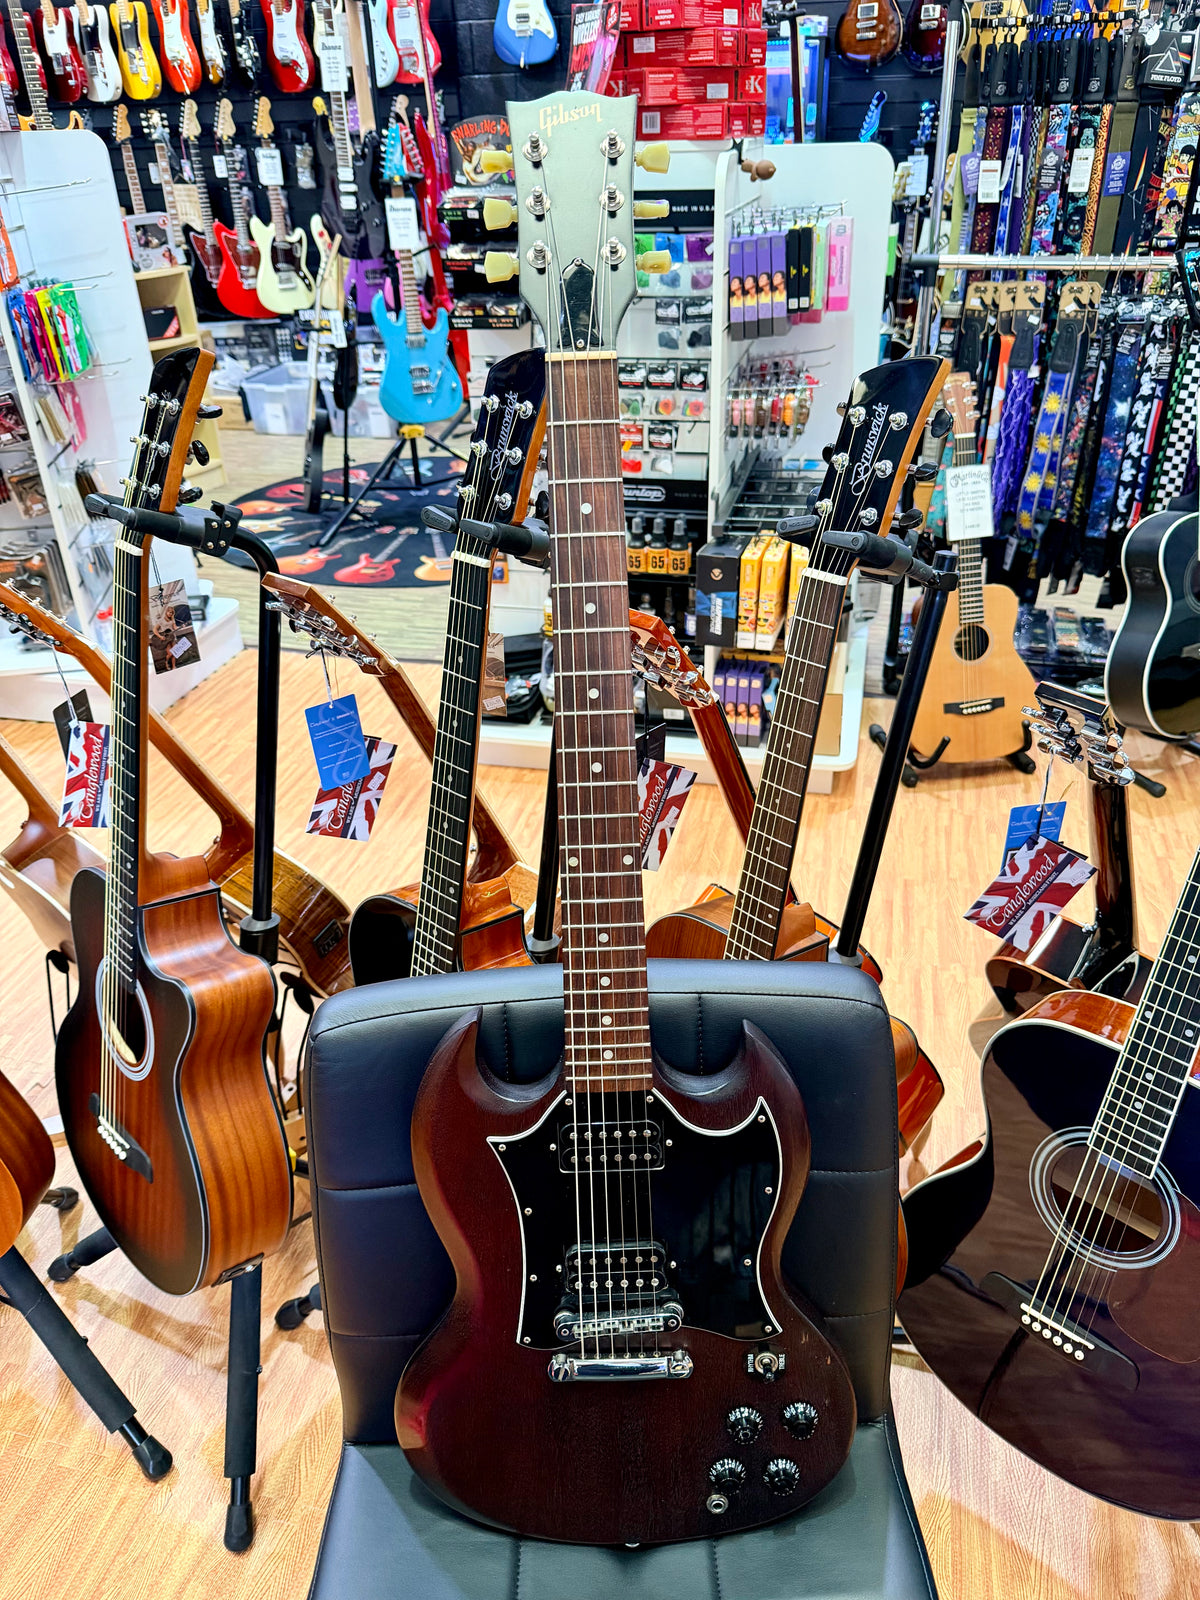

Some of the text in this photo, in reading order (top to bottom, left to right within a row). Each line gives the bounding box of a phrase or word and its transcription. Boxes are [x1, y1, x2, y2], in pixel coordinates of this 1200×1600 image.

[1150, 74, 1182, 83] PINK FLOYD
[539, 103, 602, 138] Gibson
[489, 390, 519, 481] Brunswick
[849, 402, 889, 496] Brunswick
[624, 487, 662, 500] unlop
[628, 556, 641, 569] 65
[651, 556, 665, 569] 65
[672, 558, 686, 571] 65
[80, 734, 103, 823] Tanglewood
[327, 781, 354, 833] Tangle
[640, 774, 667, 843] nglewood
[986, 853, 1056, 927] Tanglewood
